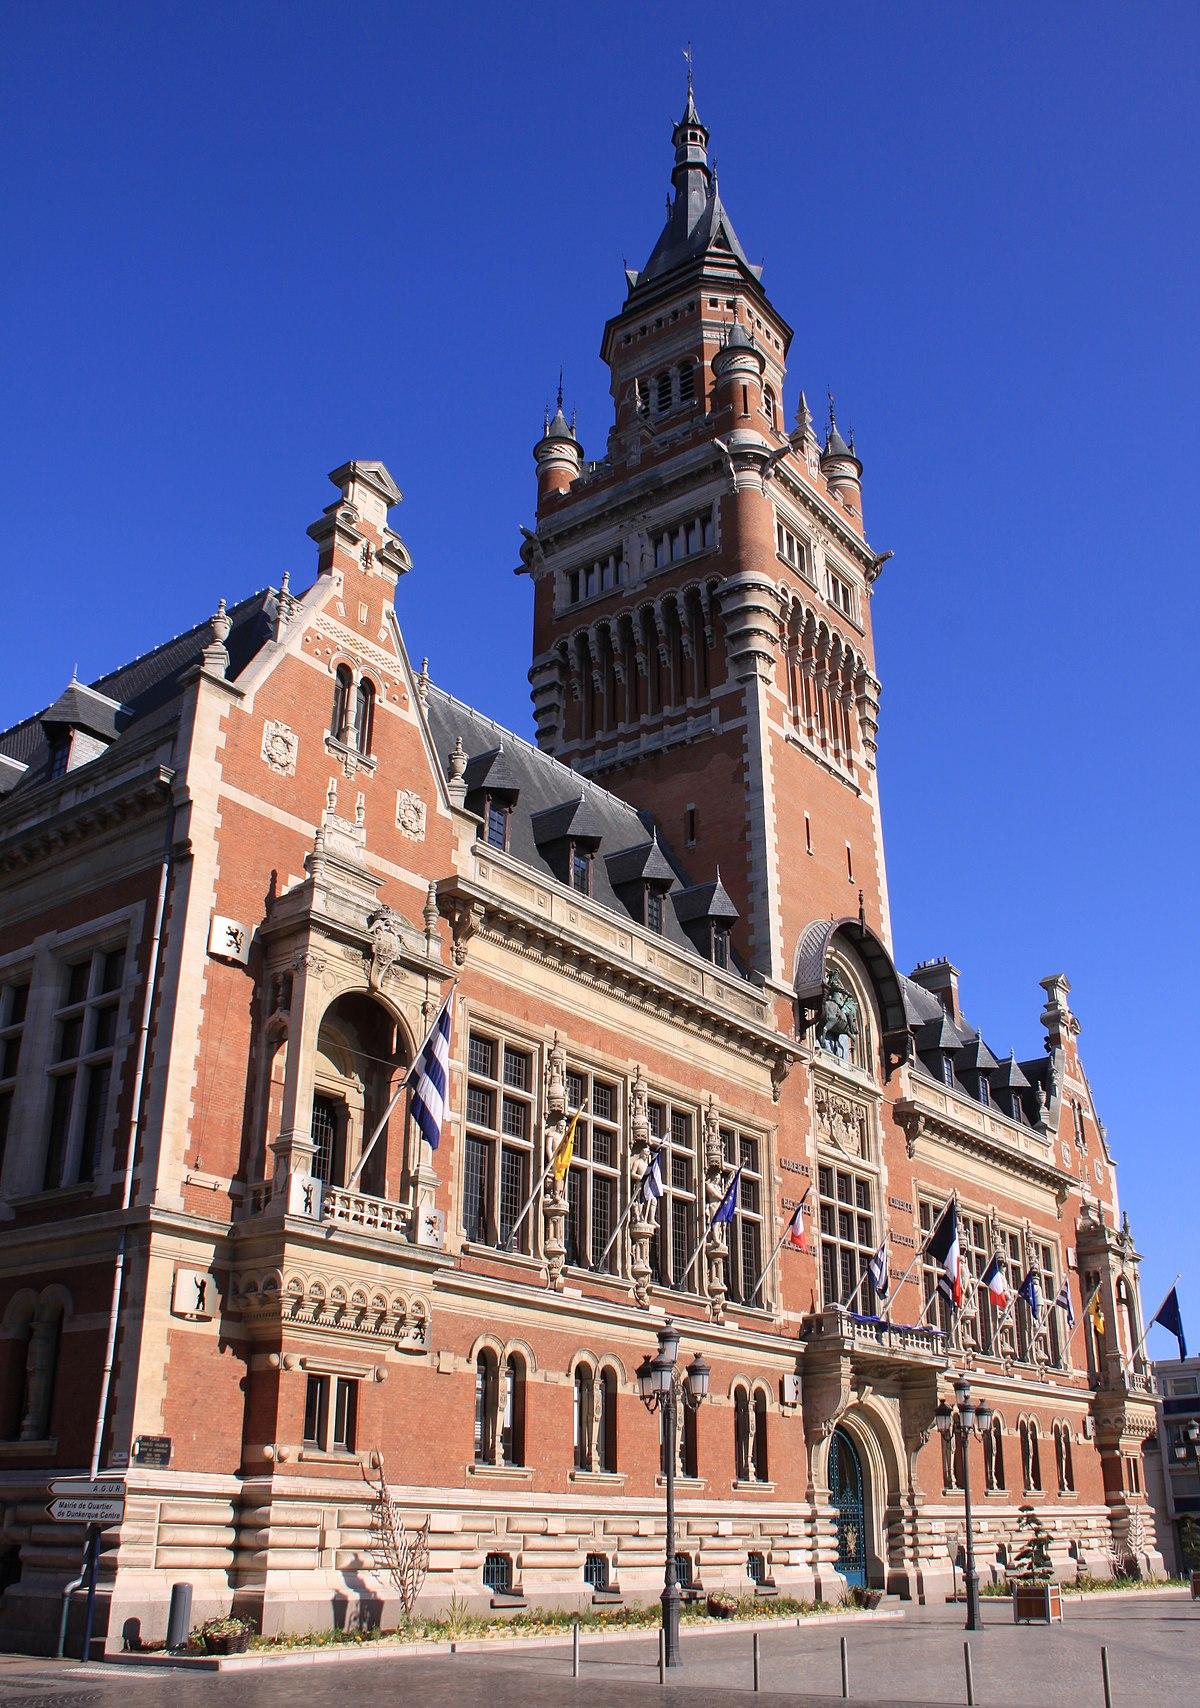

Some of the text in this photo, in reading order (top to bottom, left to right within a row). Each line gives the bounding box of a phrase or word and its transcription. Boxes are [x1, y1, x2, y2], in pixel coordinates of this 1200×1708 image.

[58, 1501, 77, 1509] Mairie
[87, 1502, 112, 1510] Quartier
[66, 1511, 98, 1519] Dunkerque
[100, 1511, 120, 1519] Centre
